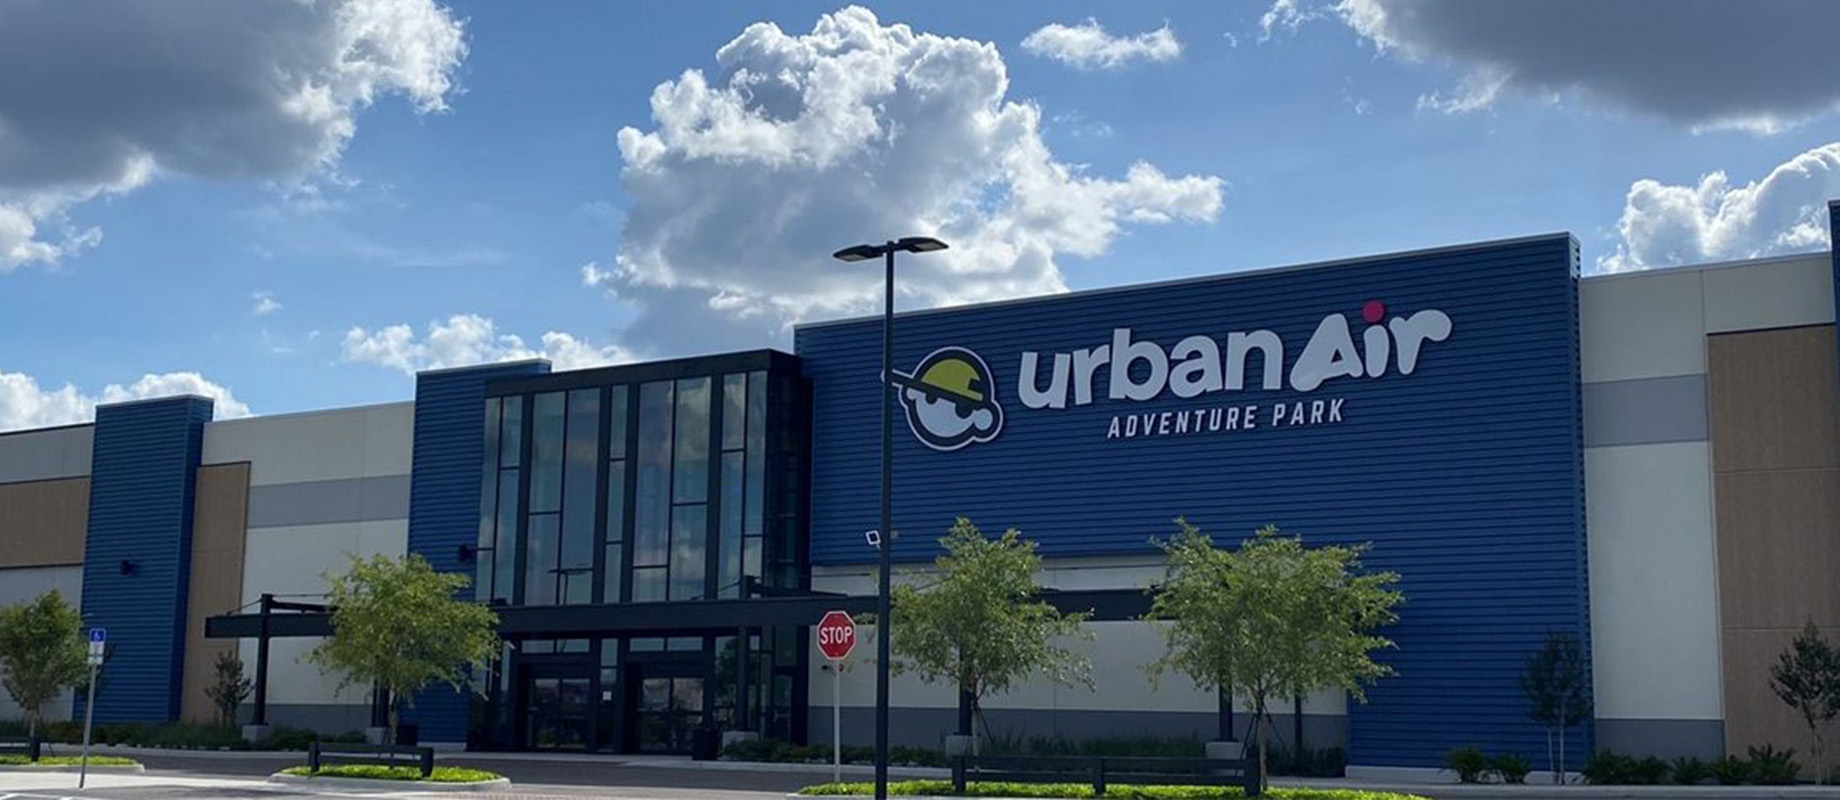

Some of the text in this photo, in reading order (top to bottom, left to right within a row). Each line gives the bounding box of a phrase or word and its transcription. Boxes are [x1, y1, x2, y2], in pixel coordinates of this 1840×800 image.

[1018, 302, 1452, 409] urban Air
[1107, 398, 1345, 438] ADVENTURE PARK
[820, 626, 853, 645] STOP
